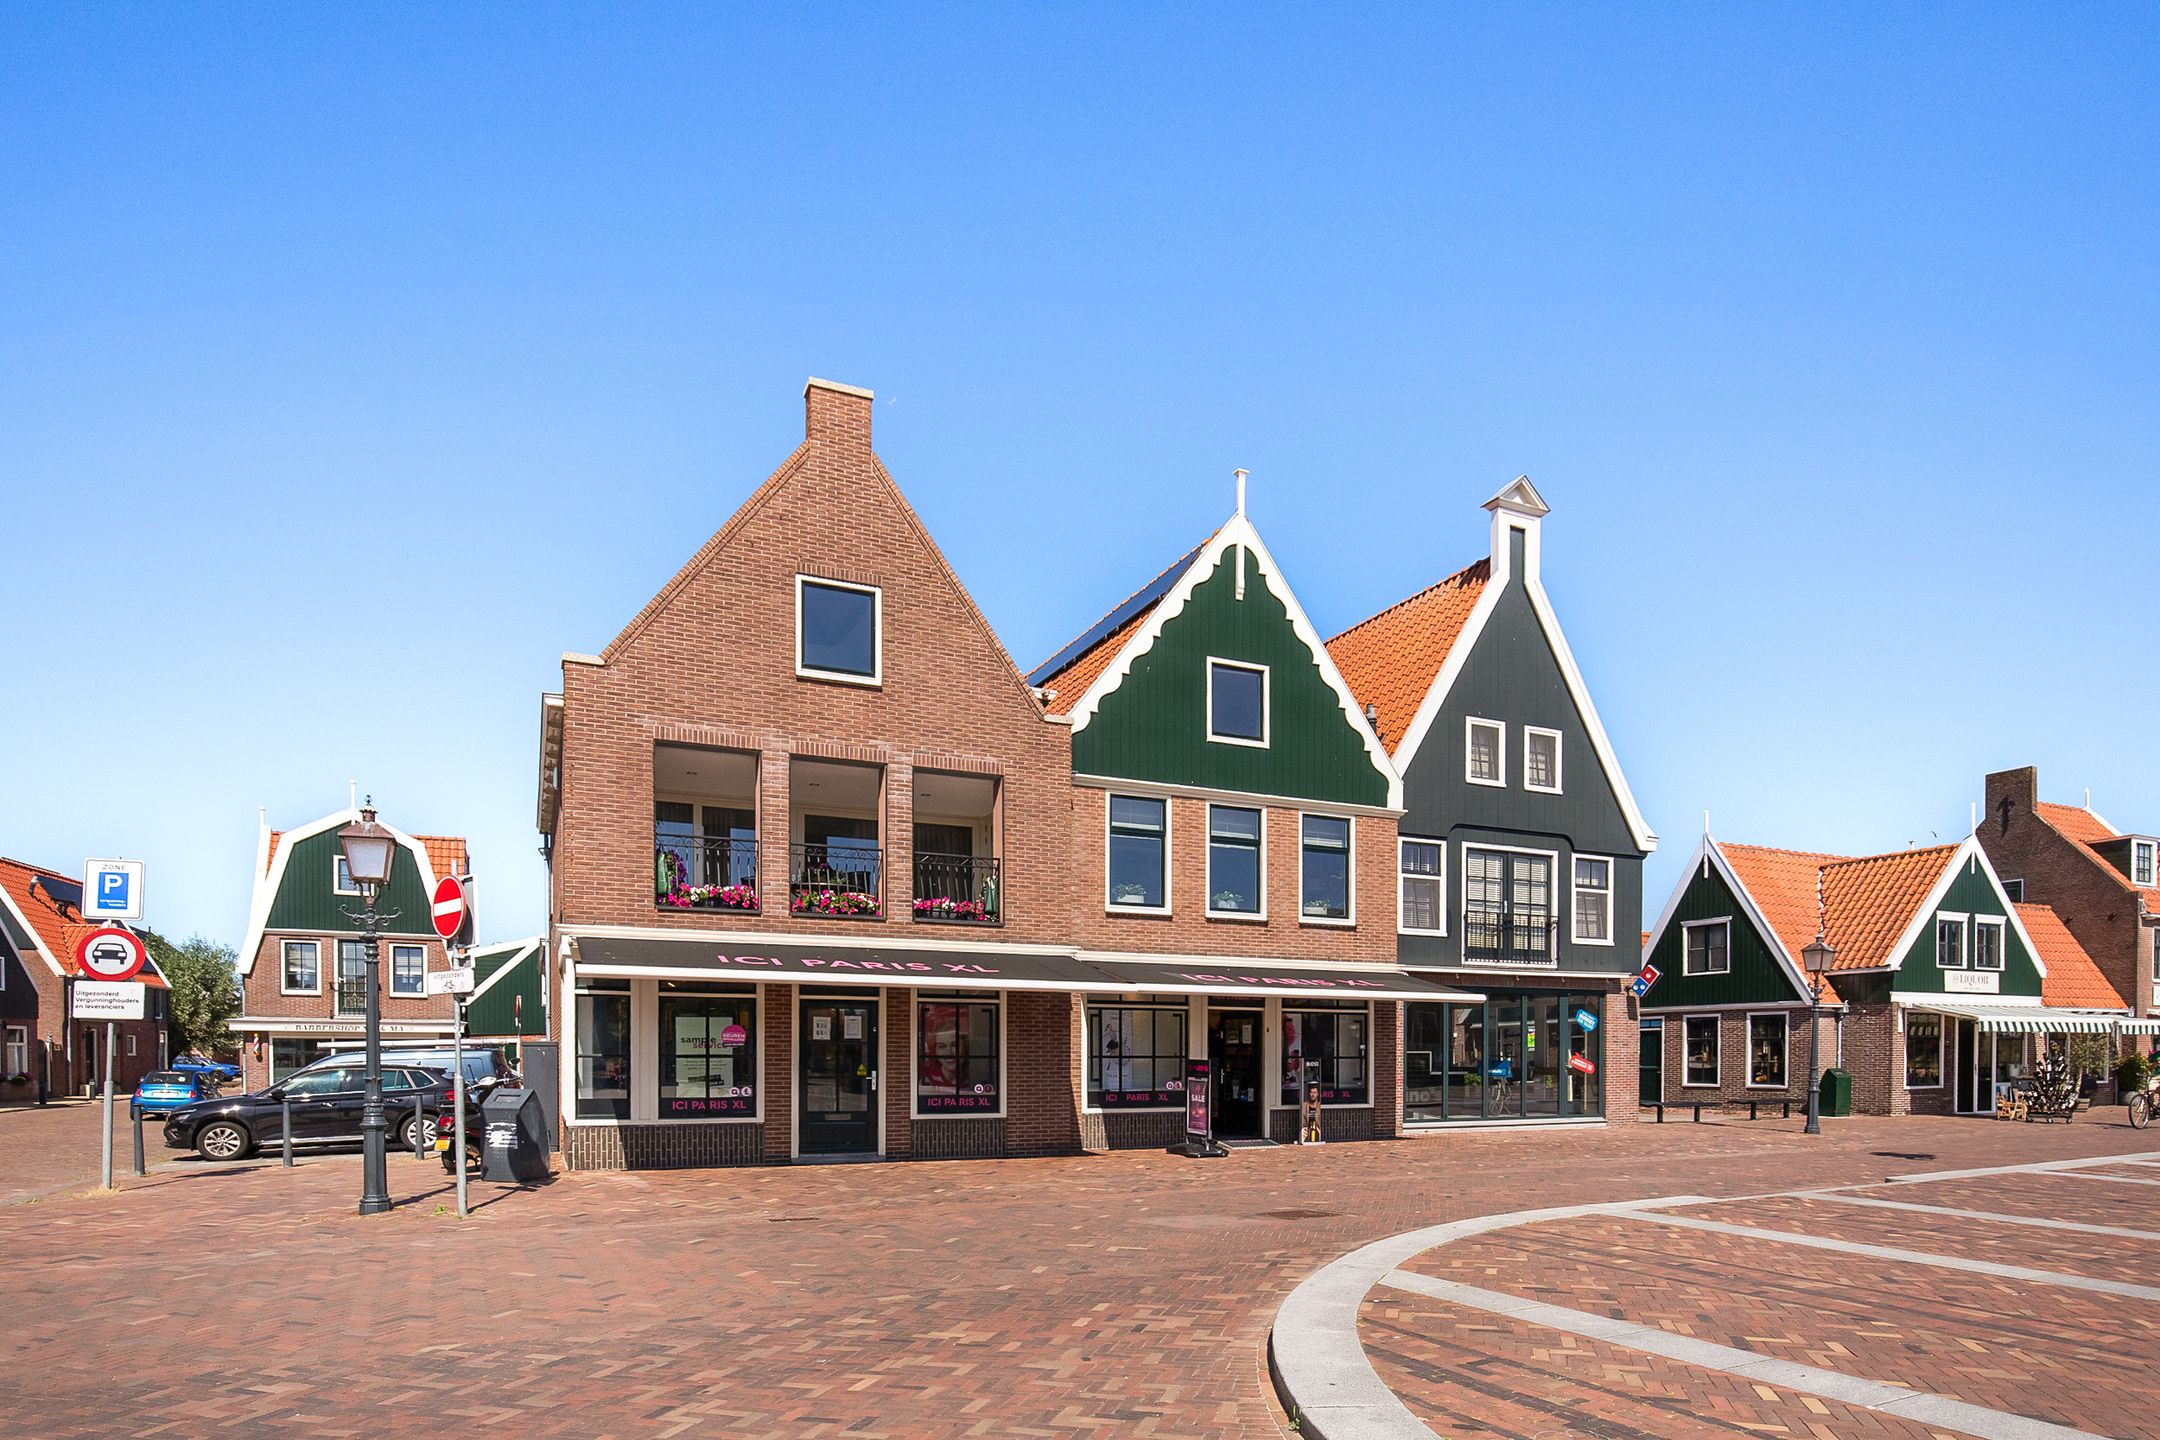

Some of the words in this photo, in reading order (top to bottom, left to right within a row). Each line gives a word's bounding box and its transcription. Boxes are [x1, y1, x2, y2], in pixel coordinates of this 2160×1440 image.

[104, 874, 123, 894] P
[717, 954, 783, 966] ICI
[800, 958, 932, 972] PARIS
[942, 963, 1000, 974] XL
[1180, 973, 1235, 983] ICI
[1238, 976, 1336, 987] PARIS
[1335, 979, 1385, 987] XL
[1960, 974, 1989, 986] LIQUOR
[295, 1024, 361, 1032] BARBERSHOP
[928, 1098, 940, 1106] ICI
[978, 1097, 991, 1106] XL
[1105, 1093, 1118, 1102] ICI
[1126, 1093, 1150, 1101] PARIS
[1158, 1093, 1168, 1101] XL
[1191, 1094, 1206, 1102] SALE
[672, 1101, 688, 1110] ICI
[732, 1100, 747, 1109] XL
